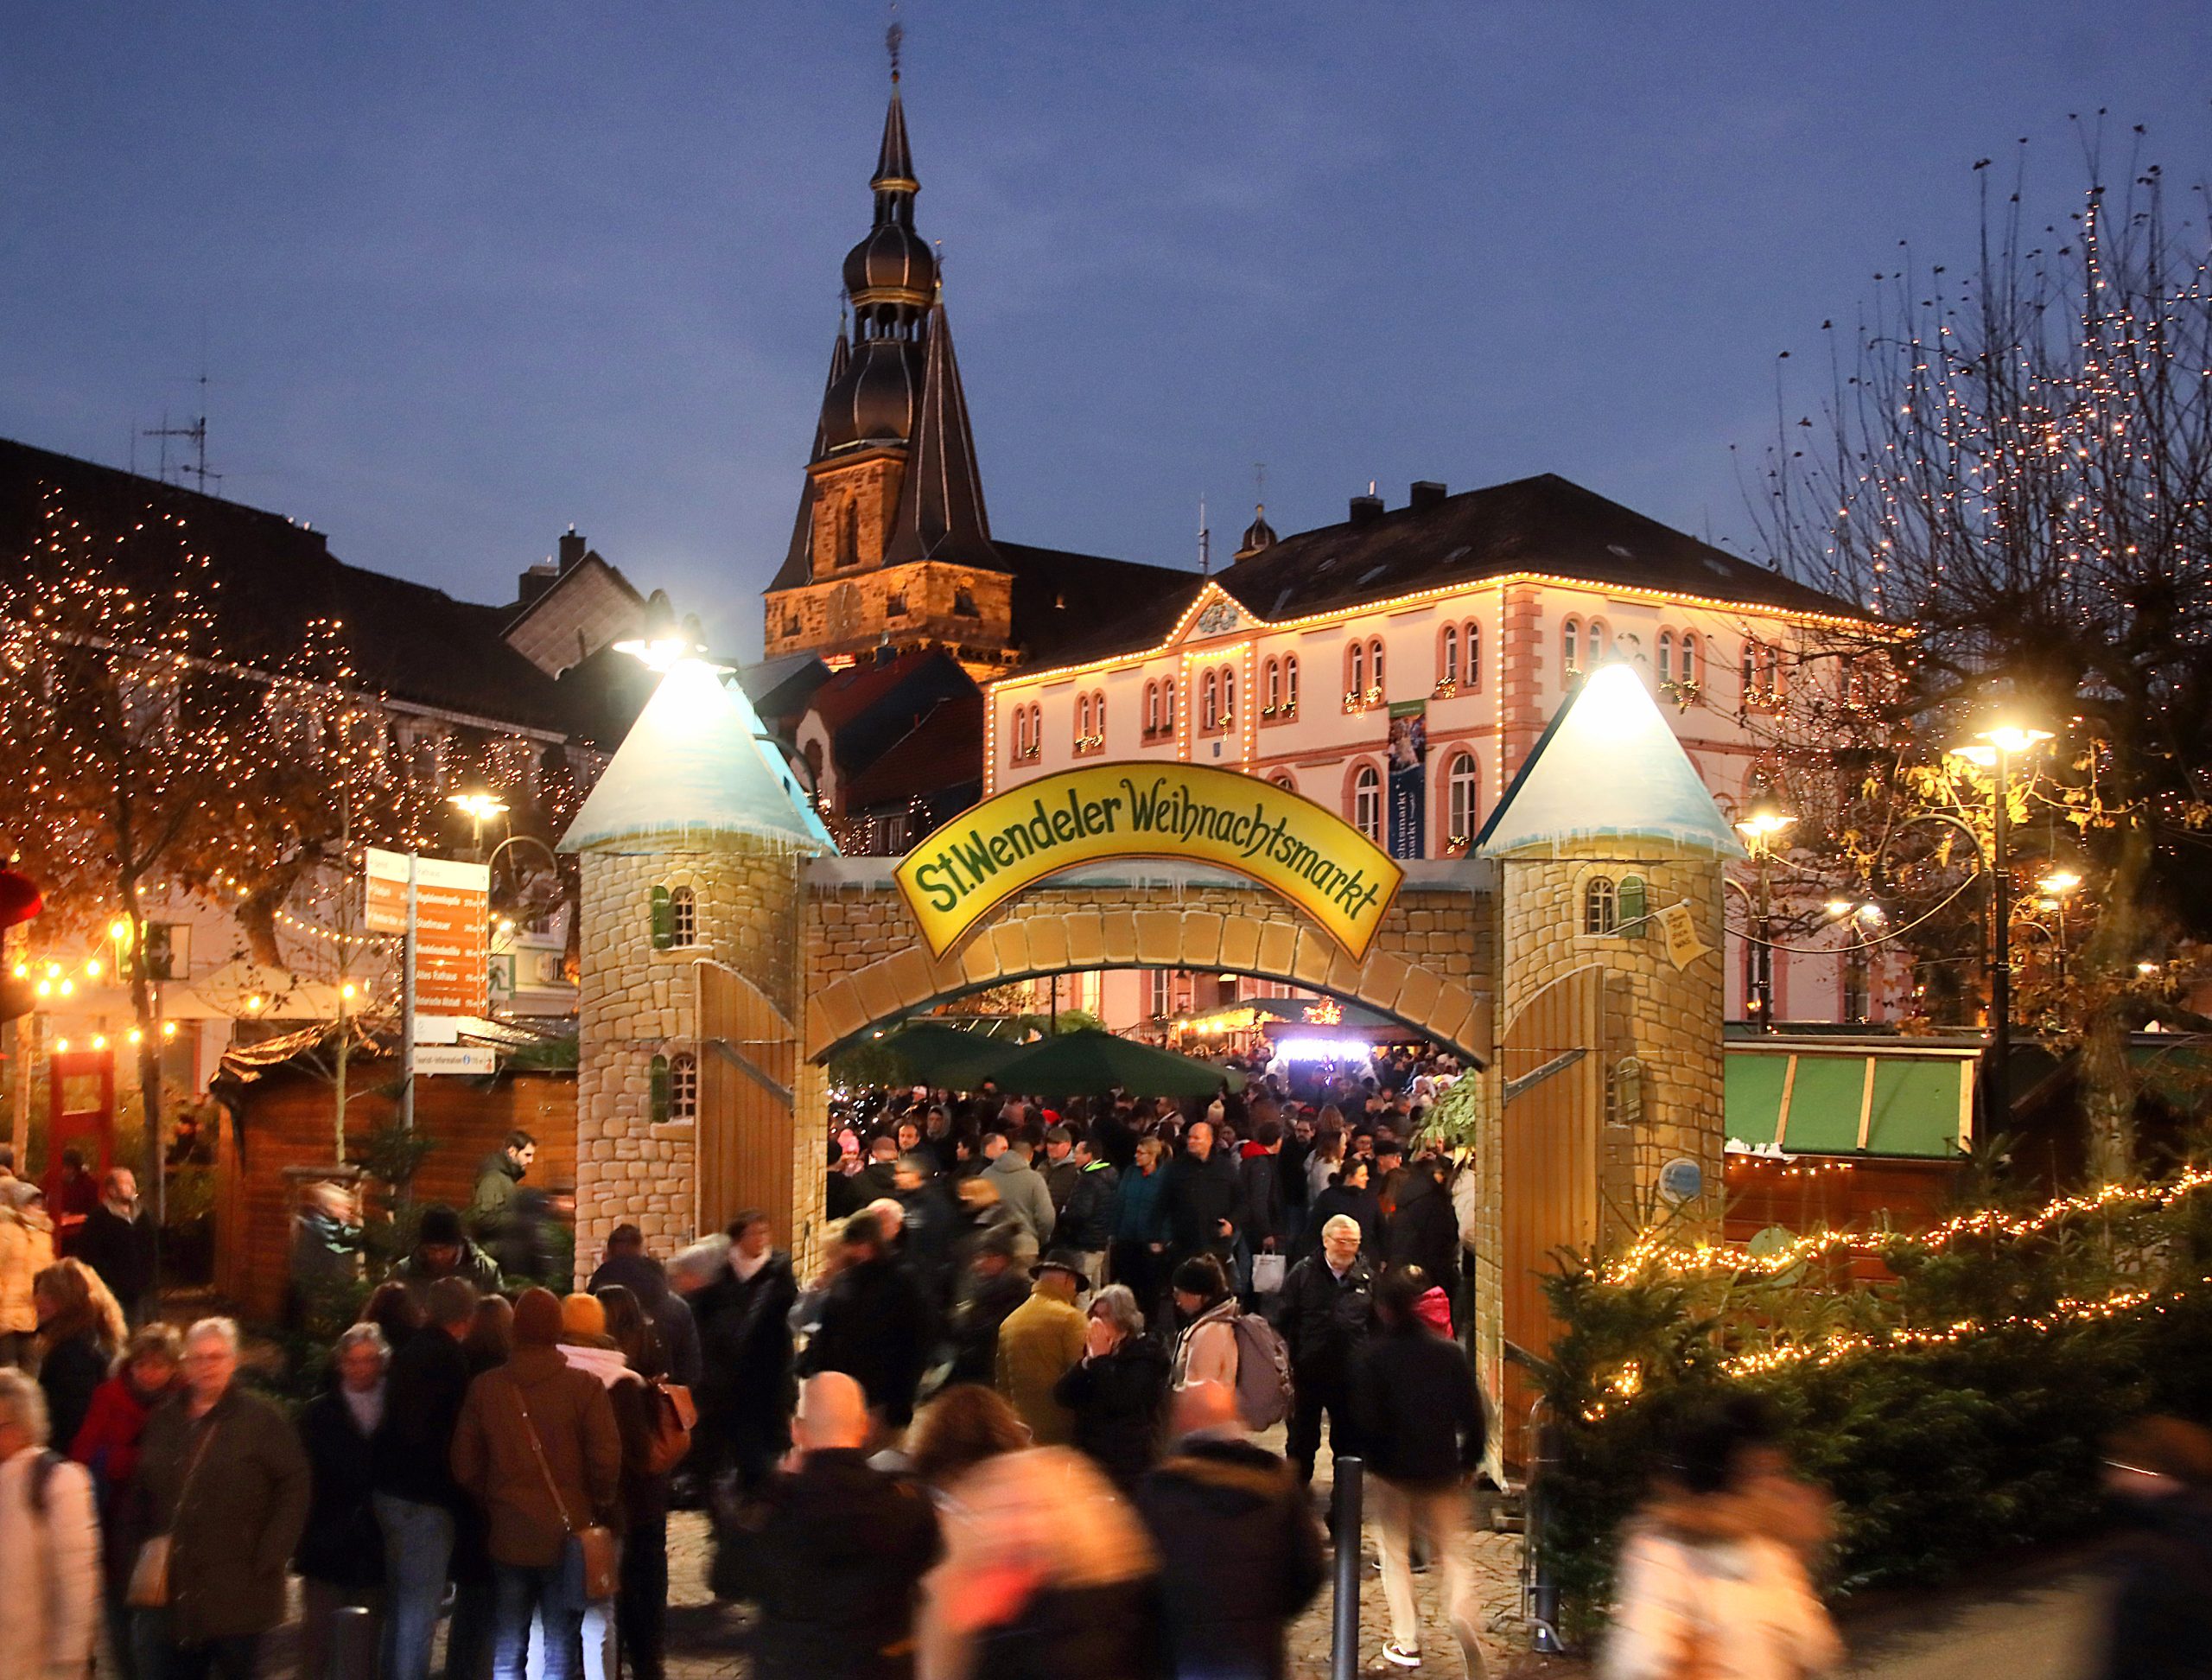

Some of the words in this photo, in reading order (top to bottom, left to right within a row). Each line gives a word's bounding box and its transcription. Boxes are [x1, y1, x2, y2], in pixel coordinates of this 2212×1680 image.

[916, 853, 976, 912] St.
[950, 788, 1121, 884] Wendeler
[1120, 778, 1379, 920] Weihnachtsmarkt
